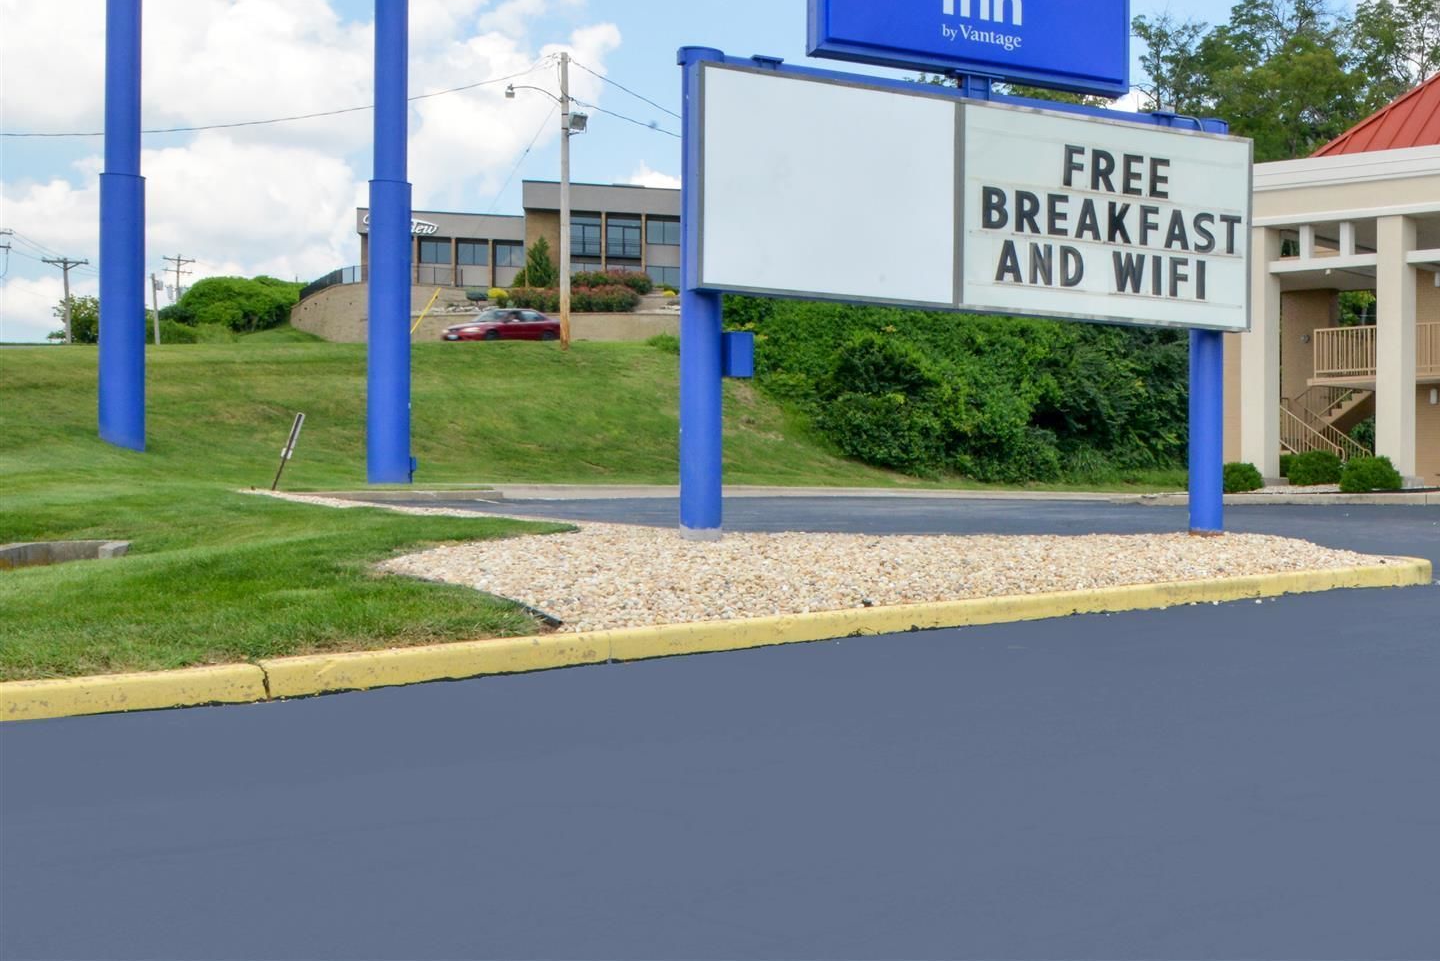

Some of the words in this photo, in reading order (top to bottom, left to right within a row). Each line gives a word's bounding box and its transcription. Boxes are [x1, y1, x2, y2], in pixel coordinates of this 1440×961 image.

[942, 24, 958, 41] by
[959, 24, 1022, 51] Vantage
[1062, 143, 1170, 199] FREE
[982, 185, 1242, 255] BREAKFAST
[994, 239, 1084, 288] AND
[1112, 250, 1206, 300] WIFI
